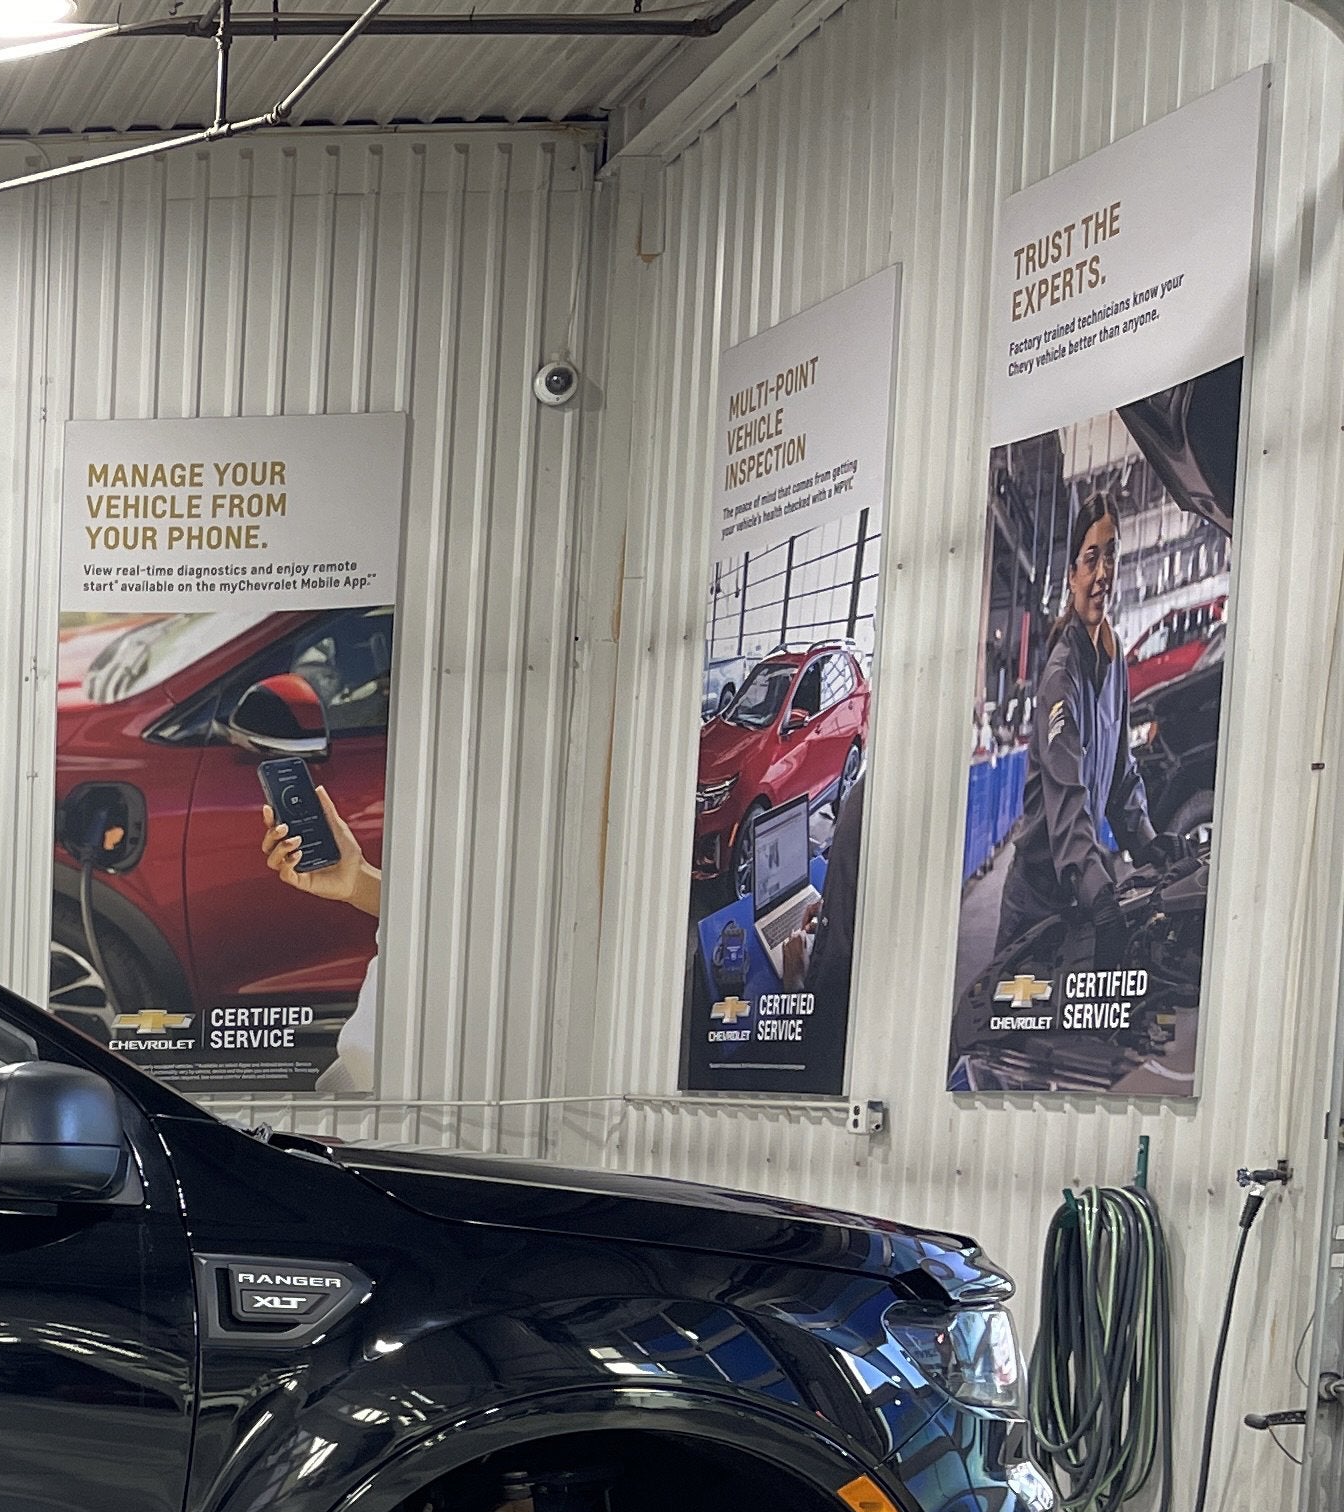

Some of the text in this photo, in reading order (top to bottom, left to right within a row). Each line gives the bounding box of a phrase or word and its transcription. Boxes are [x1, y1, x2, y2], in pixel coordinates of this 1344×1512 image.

[1013, 201, 1121, 280] TRUST THE
[1012, 254, 1106, 322] EXPERTS.
[1009, 274, 1184, 356] Factory trained technicians know your
[1008, 308, 1160, 377] Chevy vehicle better than anyone.
[729, 356, 818, 422] MULTI-POINT
[727, 408, 784, 456] VEHICLE
[88, 461, 286, 488] MANAGE YOUR
[724, 433, 806, 492] INSPECTION
[86, 493, 287, 518] VEHICLE FROM
[85, 525, 267, 550] YOUR PHONE.
[84, 561, 357, 578] View real-time diagnostics and enjoy remote
[120, 580, 174, 592] available
[178, 582, 192, 592] on
[196, 581, 216, 592] the
[220, 580, 297, 594] myChevrolet
[301, 577, 340, 590] Mobile
[1066, 970, 1148, 998] CERTIFIED
[211, 1006, 313, 1027] CERTIFIED
[759, 994, 814, 1015] CERTIFIED
[1063, 1002, 1130, 1029] SERVICE
[757, 1020, 803, 1040] SERVICE
[990, 1016, 1052, 1030] CHEVROLET
[109, 1039, 196, 1050] CHEVROLET
[210, 1029, 294, 1049] SERVICE
[708, 1030, 751, 1042] CHEVROLET
[238, 1273, 342, 1288] RANGER
[252, 1296, 306, 1308] XLT
